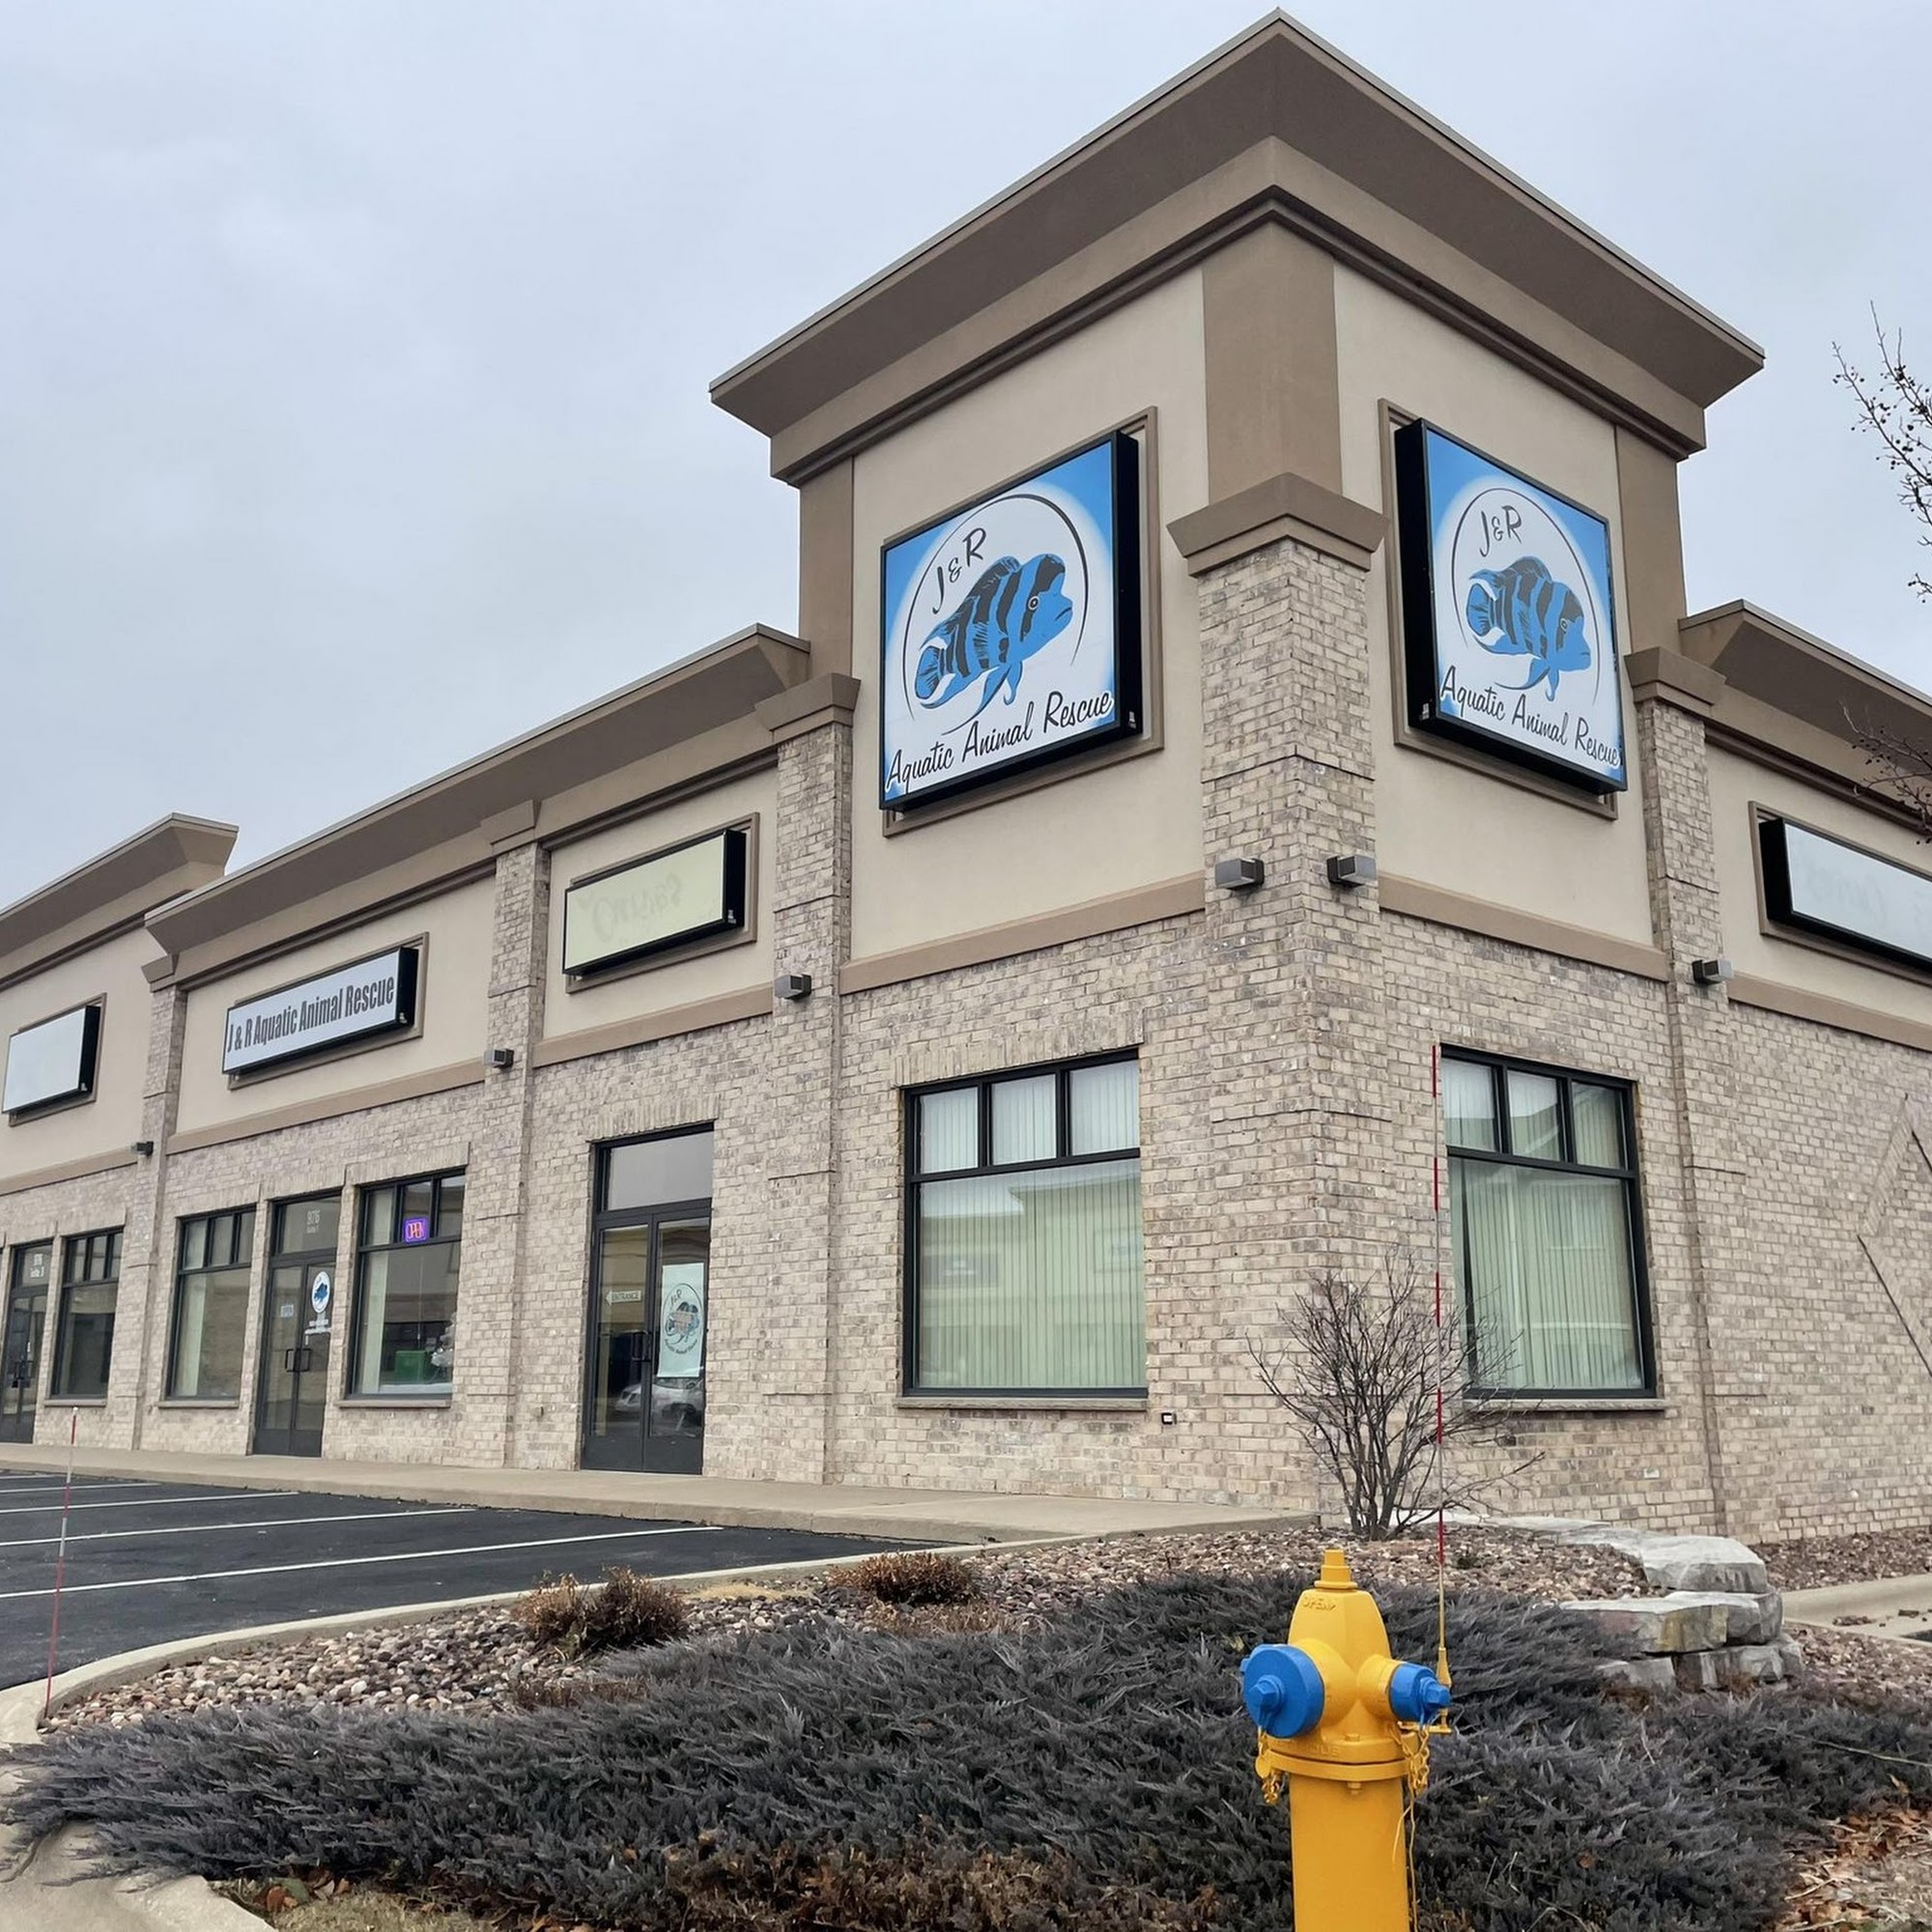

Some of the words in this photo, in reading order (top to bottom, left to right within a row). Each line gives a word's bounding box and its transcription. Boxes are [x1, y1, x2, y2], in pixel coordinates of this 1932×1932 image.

[932, 527, 986, 613] J&R
[1480, 504, 1522, 557] J&R
[887, 741, 953, 793] Aquatic
[961, 701, 1035, 763] Animal
[1043, 691, 1113, 732] Rescue
[1440, 666, 1506, 719] Aquatic
[1511, 695, 1569, 746] Animal
[1576, 717, 1620, 766] Rescue
[227, 1024, 234, 1053] J
[235, 1024, 242, 1050] &
[244, 1017, 252, 1048] R
[253, 1006, 298, 1046] Aquatic
[298, 988, 343, 1032] Animal
[345, 976, 394, 1017] Rescue
